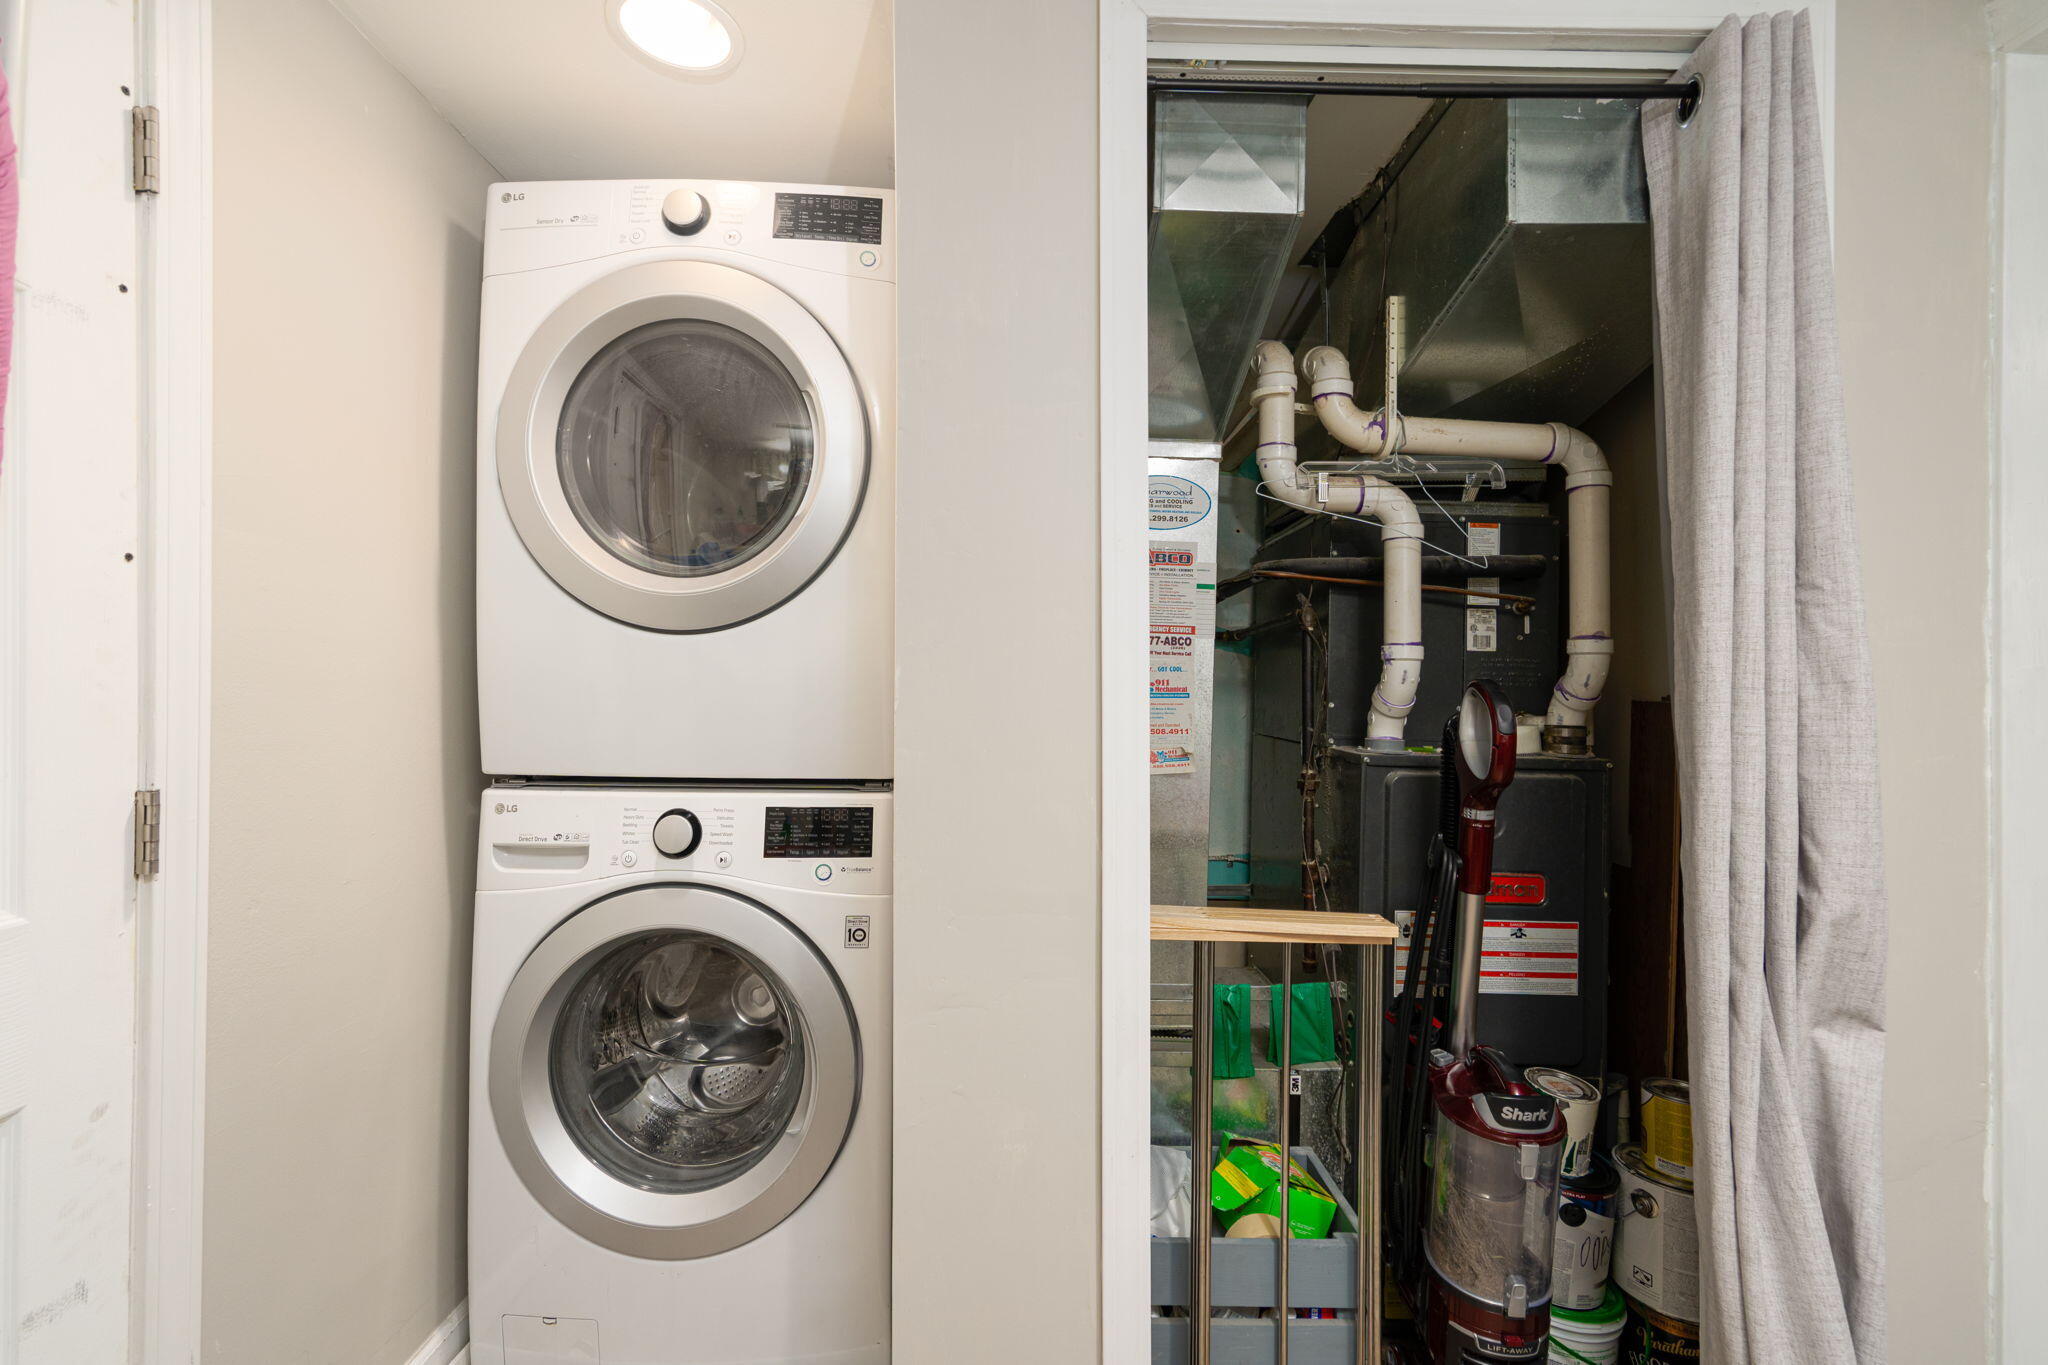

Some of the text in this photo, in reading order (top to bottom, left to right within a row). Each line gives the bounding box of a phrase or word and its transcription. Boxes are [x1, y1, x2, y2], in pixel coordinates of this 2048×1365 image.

[513, 193, 525, 201] LG
[506, 804, 518, 812] LG
[1501, 1106, 1550, 1122] Shark
